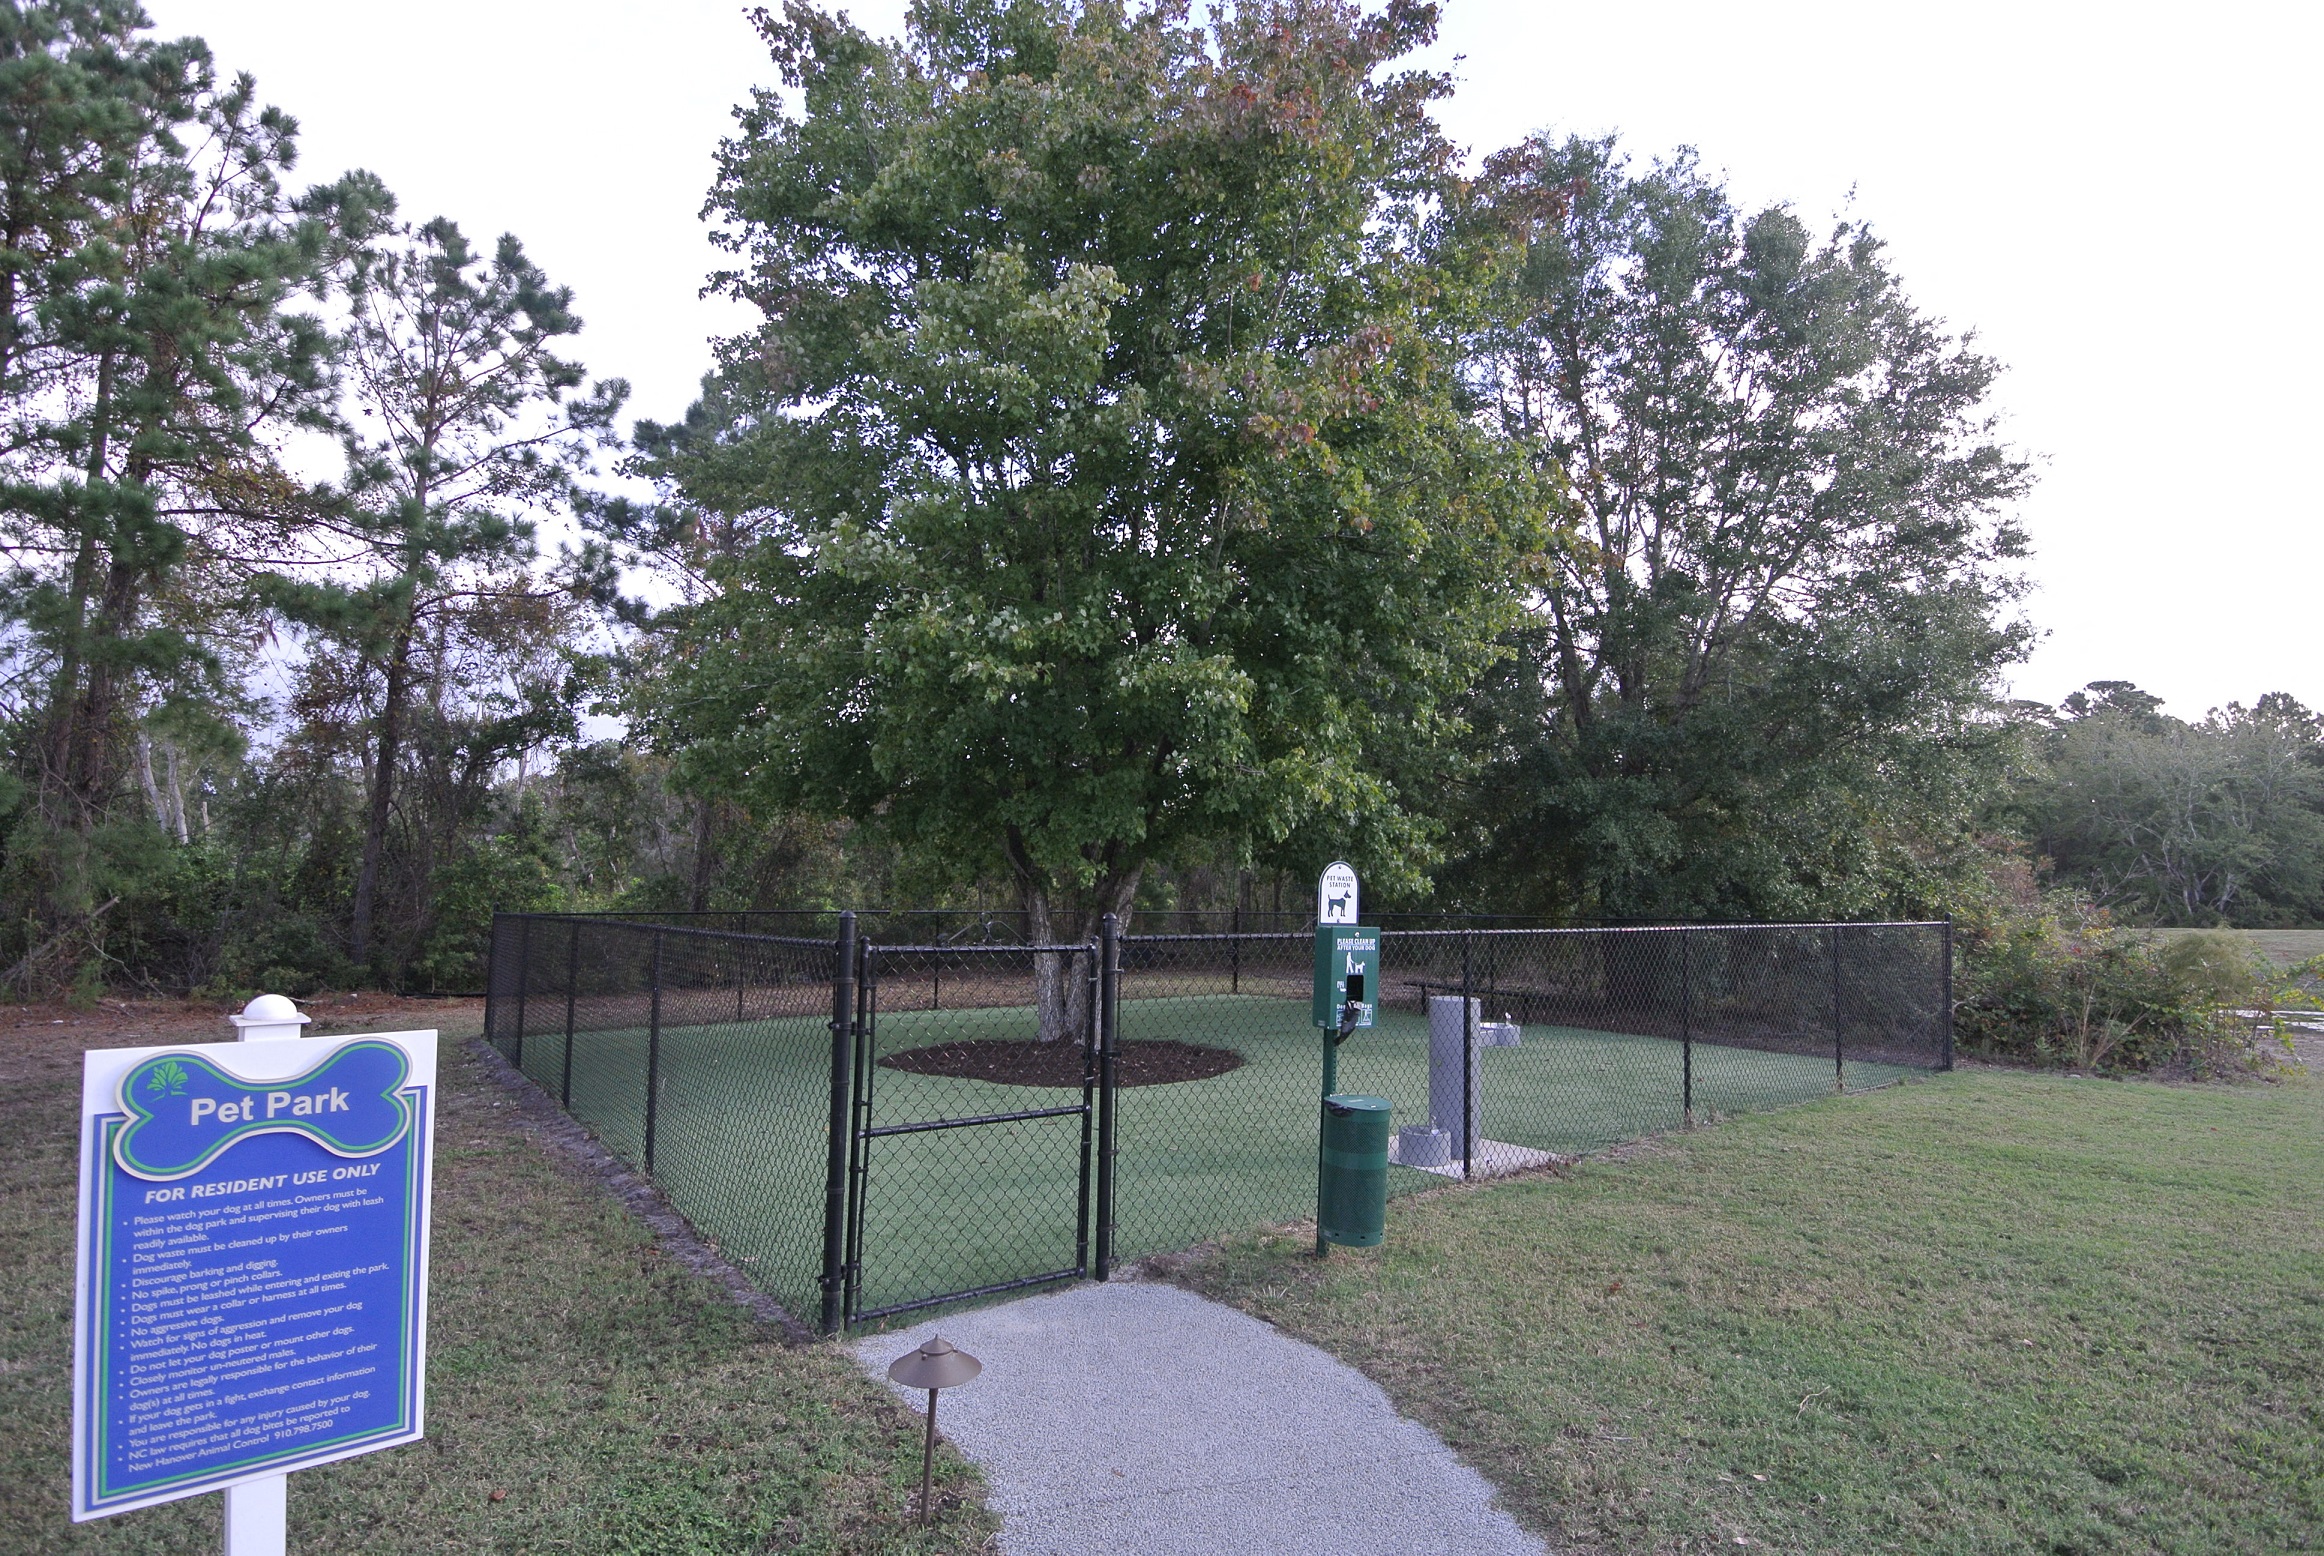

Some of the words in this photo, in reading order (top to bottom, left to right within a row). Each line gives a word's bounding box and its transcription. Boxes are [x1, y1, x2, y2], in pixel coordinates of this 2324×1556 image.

[190, 1095, 254, 1126] Pet
[266, 1087, 350, 1118] Park
[144, 1188, 185, 1204] FOR
[191, 1175, 288, 1199] RESIDENT
[292, 1170, 328, 1186] USE
[332, 1163, 381, 1180] ONLY
[133, 1227, 164, 1238] within
[166, 1224, 183, 1234] the
[185, 1222, 204, 1232] dog
[205, 1218, 227, 1230] park
[229, 1215, 247, 1225] and
[248, 1209, 299, 1223] supervising
[300, 1205, 322, 1215] their
[323, 1203, 340, 1212] dog
[342, 1199, 361, 1209] with
[363, 1196, 384, 1206] leash
[134, 1216, 165, 1225] Please
[167, 1210, 196, 1221] watch
[198, 1208, 222, 1219] your
[223, 1205, 241, 1215] dog
[254, 1200, 265, 1210] all
[267, 1199, 294, 1208] times.
[295, 1194, 331, 1204] Owners
[333, 1190, 355, 1199] must
[133, 1253, 155, 1263] Dog
[157, 1249, 186, 1259] waste
[188, 1245, 212, 1255] must
[214, 1243, 226, 1251] be
[228, 1236, 263, 1249] cleaned
[265, 1236, 278, 1245] up
[279, 1233, 291, 1243] by
[292, 1230, 314, 1239] their
[315, 1225, 348, 1236] owners
[134, 1238, 166, 1250] readily
[168, 1233, 210, 1246] available.
[132, 1273, 188, 1288] Discourage
[189, 1267, 225, 1279] barking
[226, 1262, 244, 1273] and
[246, 1259, 279, 1271] digging.
[132, 1290, 150, 1300] No
[151, 1286, 179, 1298] spike,
[180, 1282, 209, 1295] prong
[224, 1274, 249, 1287] pinch
[251, 1270, 283, 1281] collars.
[133, 1259, 192, 1275] immediately.
[131, 1315, 158, 1325] Dogs
[160, 1310, 184, 1320] must
[186, 1305, 211, 1315] wear
[220, 1299, 247, 1310] collar
[262, 1291, 297, 1302] harness
[309, 1285, 319, 1294] all
[321, 1282, 347, 1292] times.
[132, 1302, 158, 1312] Dogs
[160, 1297, 185, 1308] must
[186, 1295, 199, 1304] be
[201, 1287, 236, 1301] leashed
[238, 1284, 263, 1294] while
[265, 1278, 302, 1290] entering
[304, 1273, 320, 1284] and
[322, 1270, 351, 1281] exiting
[352, 1267, 367, 1275] the
[368, 1262, 390, 1275] park.
[130, 1336, 164, 1349] Watch
[166, 1334, 181, 1343] for
[183, 1330, 206, 1341] signs
[208, 1326, 219, 1336] of
[220, 1319, 268, 1335] aggression
[269, 1314, 286, 1325] and
[288, 1309, 322, 1321] remove
[324, 1305, 345, 1317] your
[346, 1302, 363, 1310] dog
[131, 1327, 148, 1337] No
[150, 1320, 198, 1335] aggressive
[200, 1315, 225, 1325] dogs.
[130, 1344, 190, 1362] immediately.
[191, 1341, 208, 1351] No
[210, 1338, 232, 1348] dogs
[245, 1331, 267, 1341] heat.
[130, 1364, 147, 1374] Do
[149, 1361, 166, 1371] not
[169, 1359, 182, 1367] let
[184, 1354, 206, 1367] your
[208, 1350, 227, 1360] dog
[274, 1335, 304, 1347] mount
[306, 1330, 331, 1341] other
[332, 1326, 355, 1336] dogs.
[129, 1385, 170, 1399] Owners
[172, 1382, 188, 1391] are
[190, 1375, 219, 1388] legally
[221, 1364, 273, 1381] responsible
[274, 1362, 288, 1370] for
[290, 1358, 305, 1367] the
[307, 1350, 344, 1364] behavior
[346, 1346, 356, 1355] of
[357, 1343, 378, 1353] their
[130, 1373, 167, 1386] Closely
[168, 1366, 208, 1379] monitor
[210, 1352, 267, 1371] un-neutered
[268, 1349, 296, 1360] males.
[129, 1398, 160, 1411] dog(s)
[174, 1392, 185, 1402] all
[187, 1389, 216, 1400] times.
[129, 1439, 148, 1448] You
[150, 1435, 167, 1444] are
[168, 1422, 222, 1440] responsible
[223, 1419, 239, 1428] for
[240, 1415, 256, 1424] any
[258, 1409, 284, 1421] injury
[286, 1400, 316, 1414] caused
[318, 1399, 329, 1408] by
[330, 1394, 351, 1406] your
[352, 1390, 371, 1399] dog.
[129, 1424, 148, 1436] and
[149, 1421, 174, 1432] leave
[176, 1417, 192, 1426] the
[194, 1411, 218, 1425] park.
[129, 1448, 148, 1460] NC
[150, 1447, 167, 1456] law
[169, 1438, 208, 1452] requires
[210, 1433, 229, 1443] that
[230, 1428, 241, 1438] all
[243, 1426, 261, 1435] dog
[262, 1421, 284, 1431] bites
[286, 1418, 298, 1426] be
[299, 1406, 339, 1423] reported
[129, 1462, 153, 1472] New
[155, 1452, 198, 1467] Hanover
[198, 1442, 231, 1457] Animal
[233, 1434, 270, 1449] Control
[274, 1419, 333, 1439] 910.798.7500
